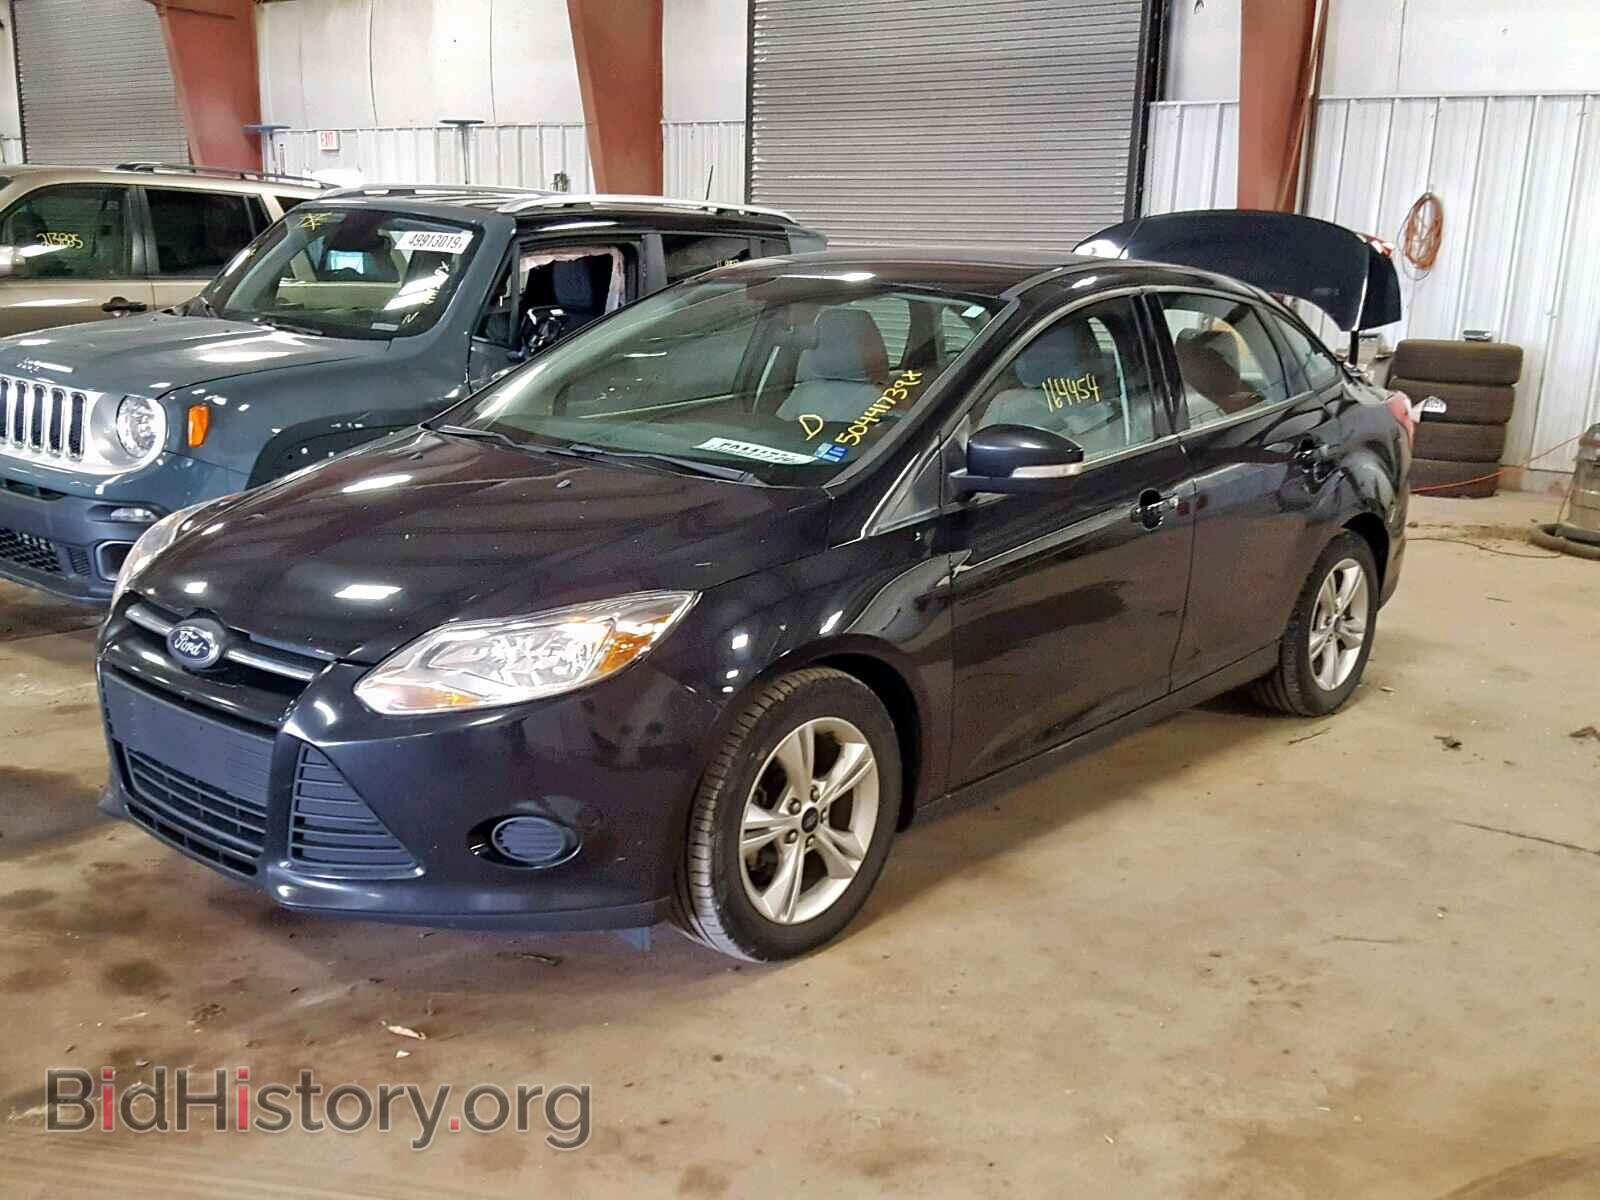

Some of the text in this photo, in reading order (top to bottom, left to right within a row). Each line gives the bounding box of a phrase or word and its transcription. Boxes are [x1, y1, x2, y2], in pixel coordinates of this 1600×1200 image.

[1041, 373, 1100, 413] 164454
[799, 413, 823, 441] D
[174, 630, 208, 656] Ford
